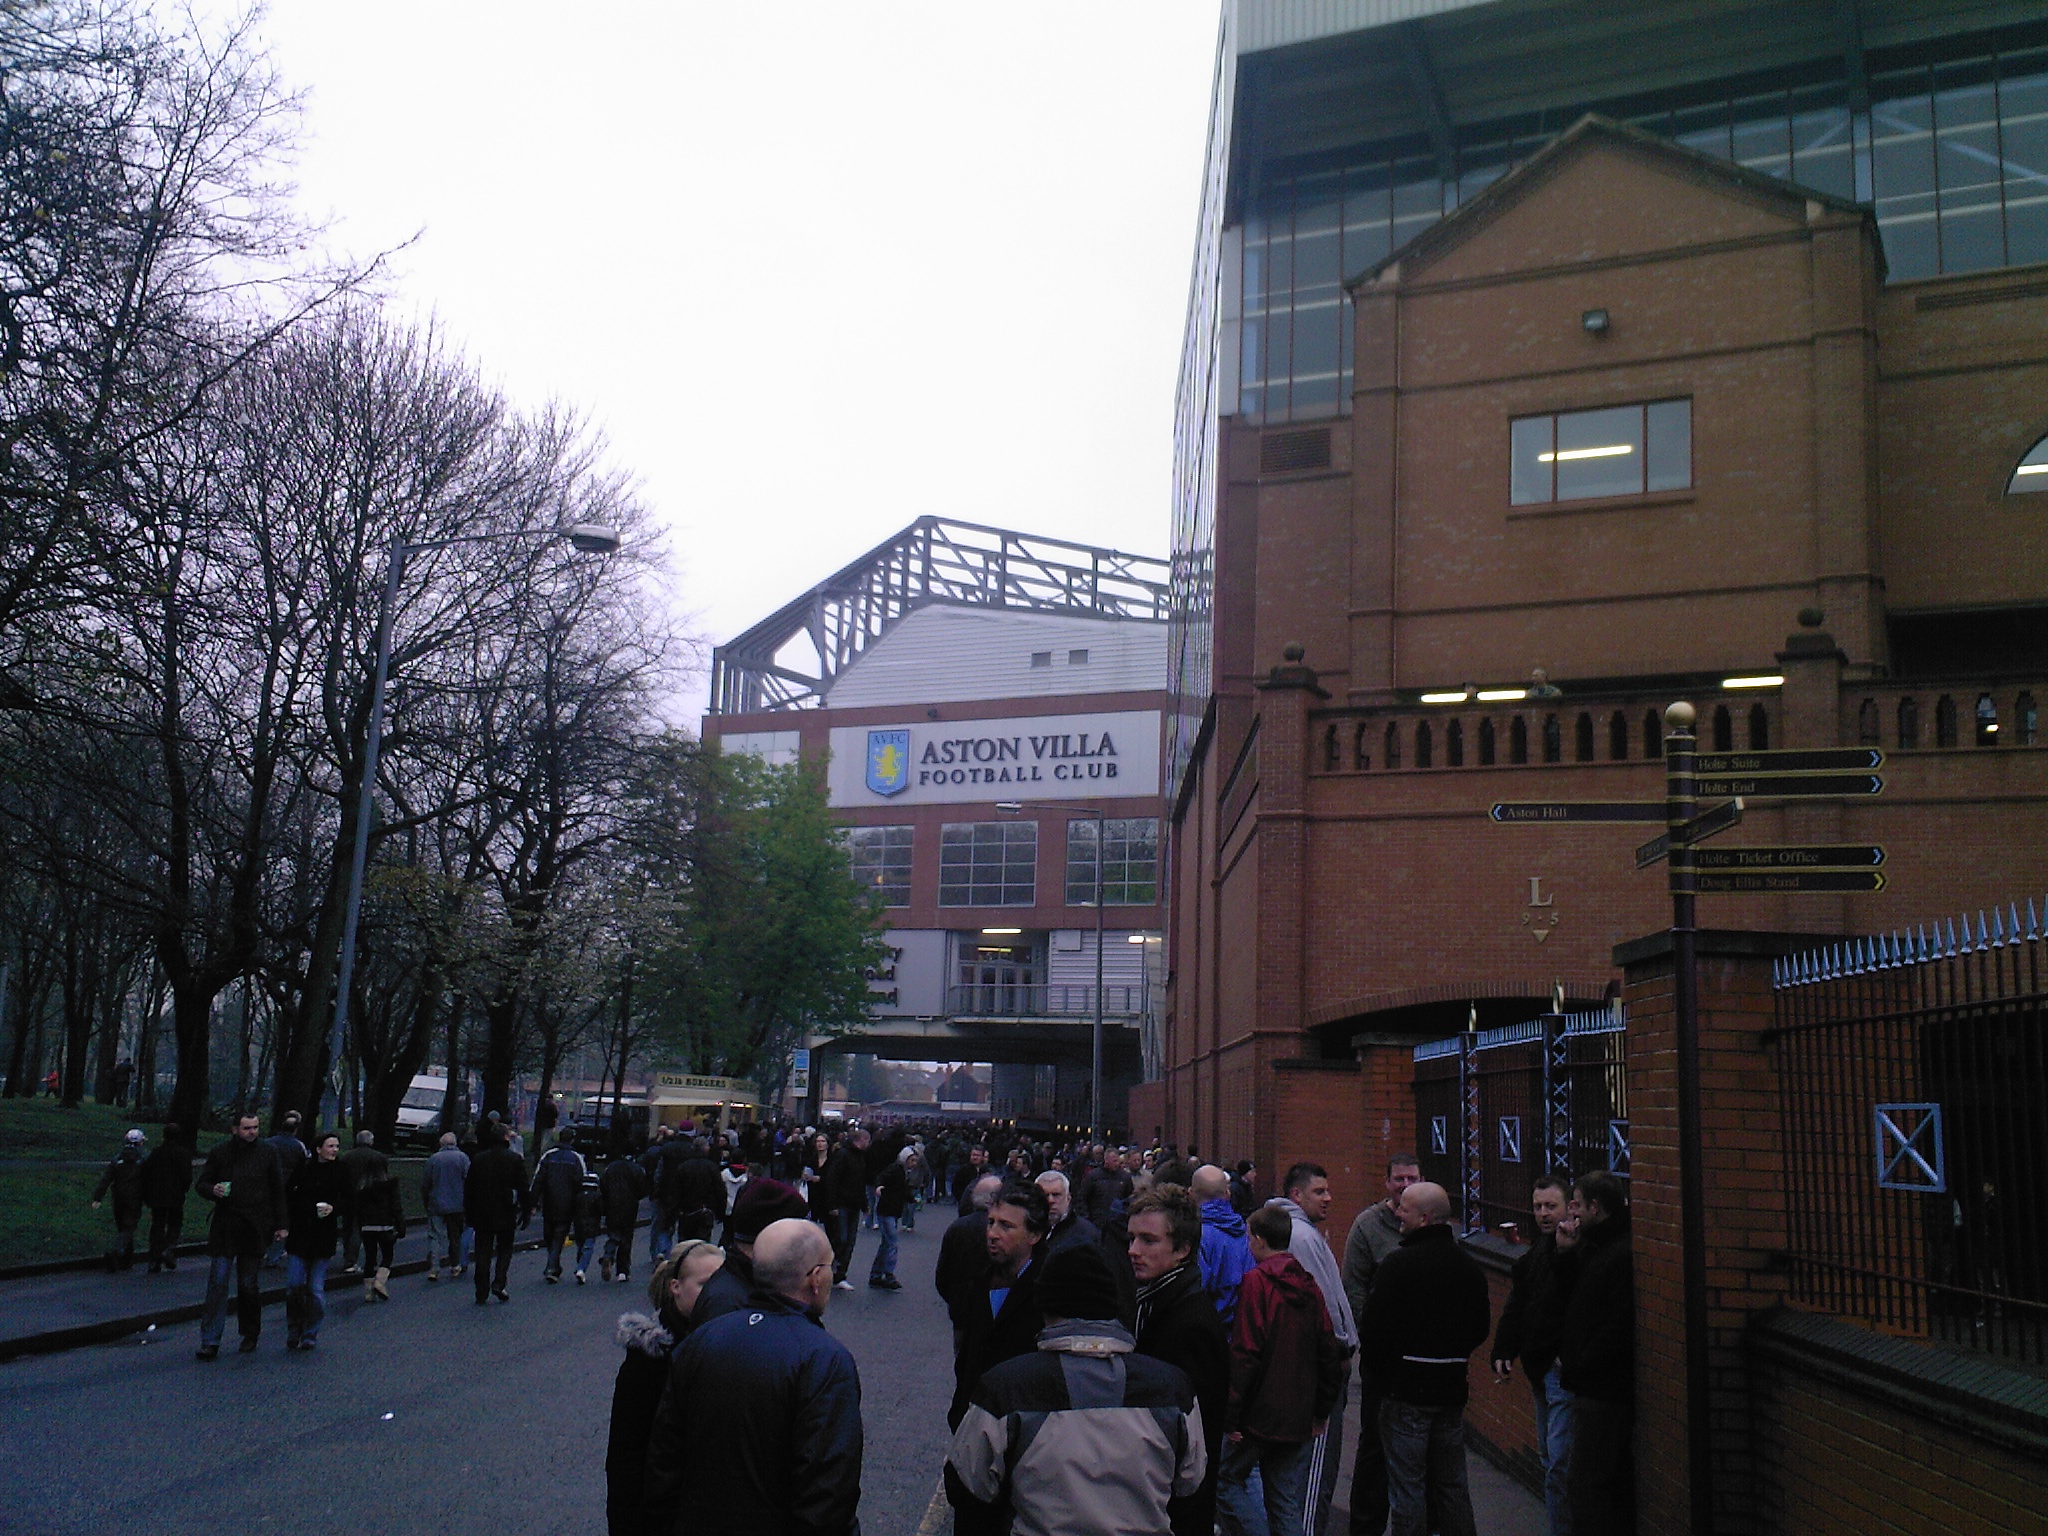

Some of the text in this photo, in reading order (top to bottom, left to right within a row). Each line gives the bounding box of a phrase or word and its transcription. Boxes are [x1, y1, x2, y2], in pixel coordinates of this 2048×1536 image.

[920, 732, 1118, 764] ASTON VILLA
[919, 762, 1119, 786] FOOTBALL CLUB
[1699, 782, 1755, 793] Holte End
[1506, 807, 1567, 818] Aston Hall
[1737, 852, 1772, 864] Ticket
[1528, 877, 1553, 907] L
